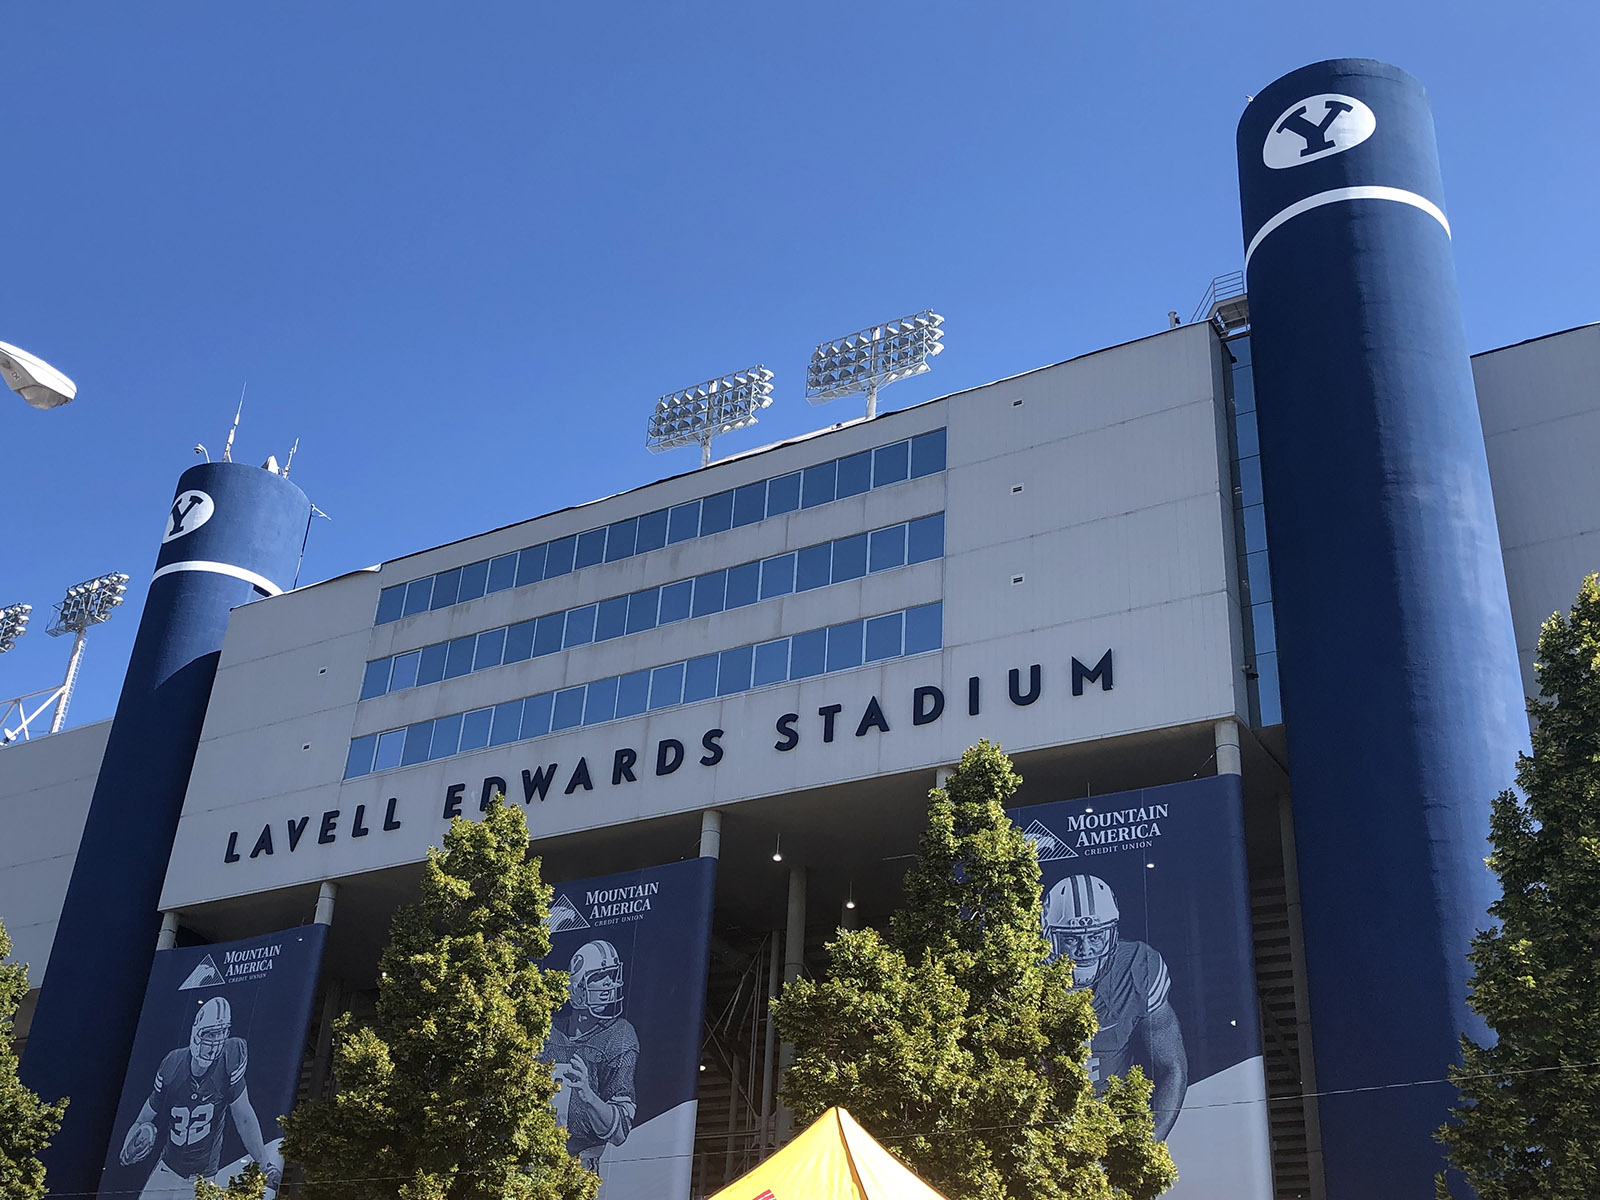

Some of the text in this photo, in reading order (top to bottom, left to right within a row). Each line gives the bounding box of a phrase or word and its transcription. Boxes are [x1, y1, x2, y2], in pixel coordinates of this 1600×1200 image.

[1276, 100, 1354, 158] Y
[168, 495, 204, 537] Y
[224, 648, 1113, 863] LAVELL EDWARDS STADIUM
[1067, 804, 1168, 832] MOUNTAIN
[1075, 822, 1161, 848] AMERICA
[1084, 840, 1153, 856] CREDIT UNION
[585, 882, 659, 905] MOUNTAIN
[589, 898, 651, 920] AMERICA
[594, 914, 644, 927] CREDIT UNION
[223, 945, 281, 964] MOUNTAIN
[226, 960, 273, 976] AMERICA
[171, 1102, 214, 1147] 32
